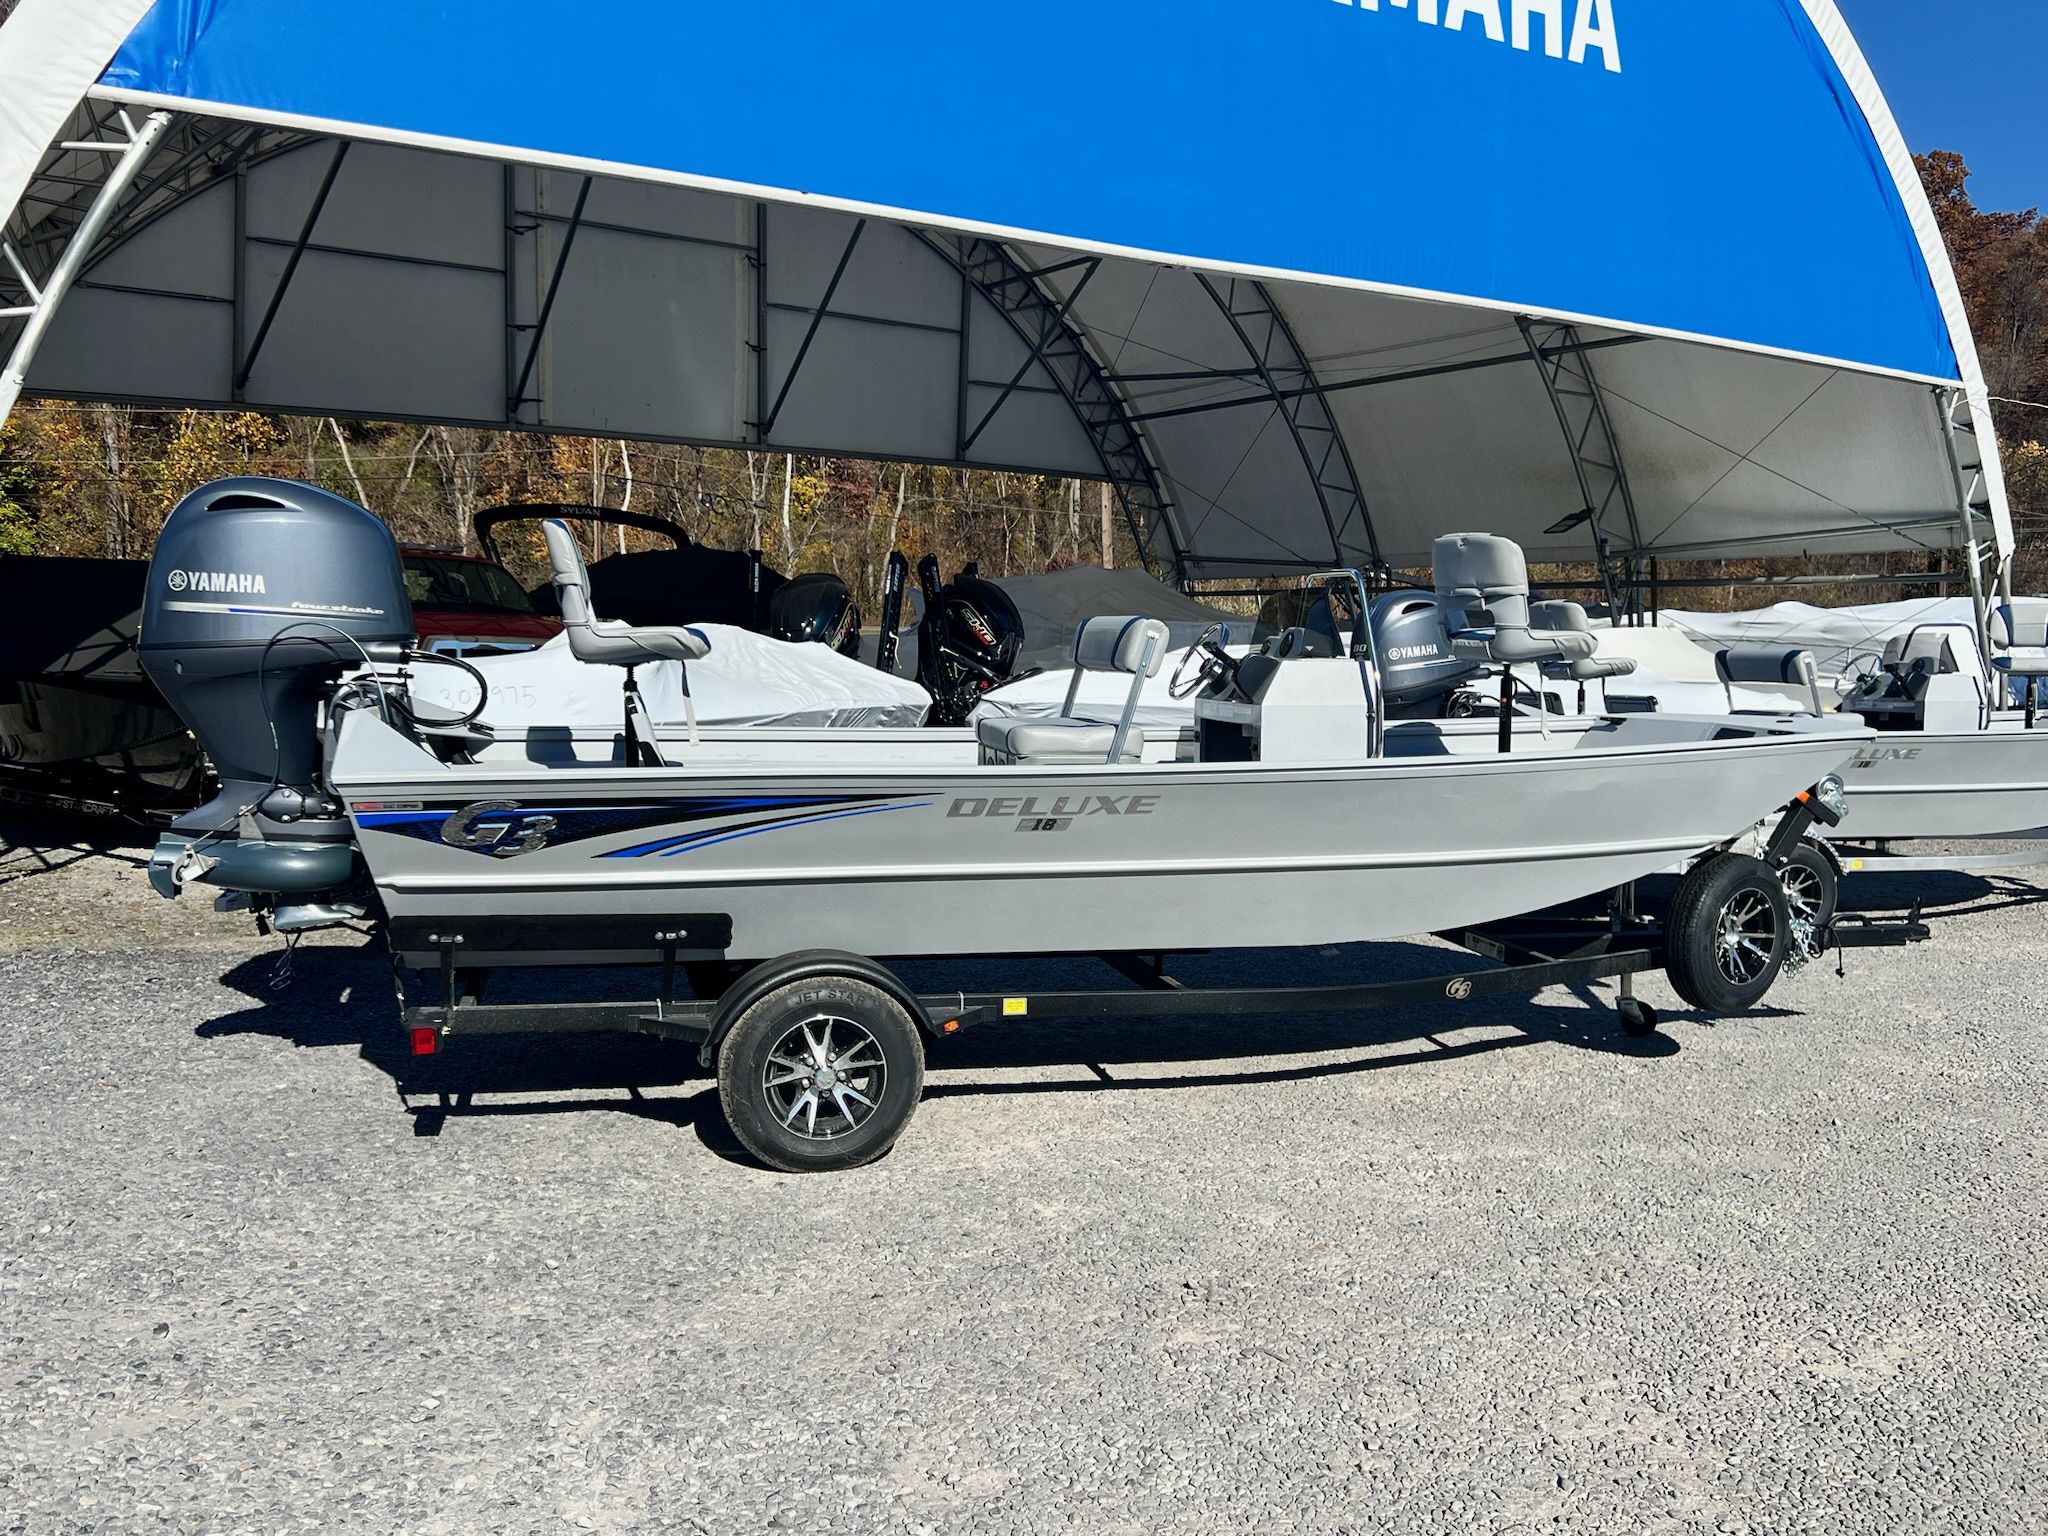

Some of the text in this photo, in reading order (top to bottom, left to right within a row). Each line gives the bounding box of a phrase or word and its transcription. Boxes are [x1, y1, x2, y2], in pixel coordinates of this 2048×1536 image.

[560, 506, 601, 516] SYLVAN
[188, 571, 266, 594] YAMAHA
[1400, 644, 1439, 659] YAMAHA
[1848, 748, 1923, 761] LUXE
[62, 799, 114, 816] STRCRAFT
[946, 795, 1161, 818] DELUXE
[441, 800, 558, 856] G3
[1031, 818, 1057, 831] 18
[1445, 977, 1473, 1000] G3
[795, 990, 822, 1005] JET
[827, 989, 865, 1006] STAR
